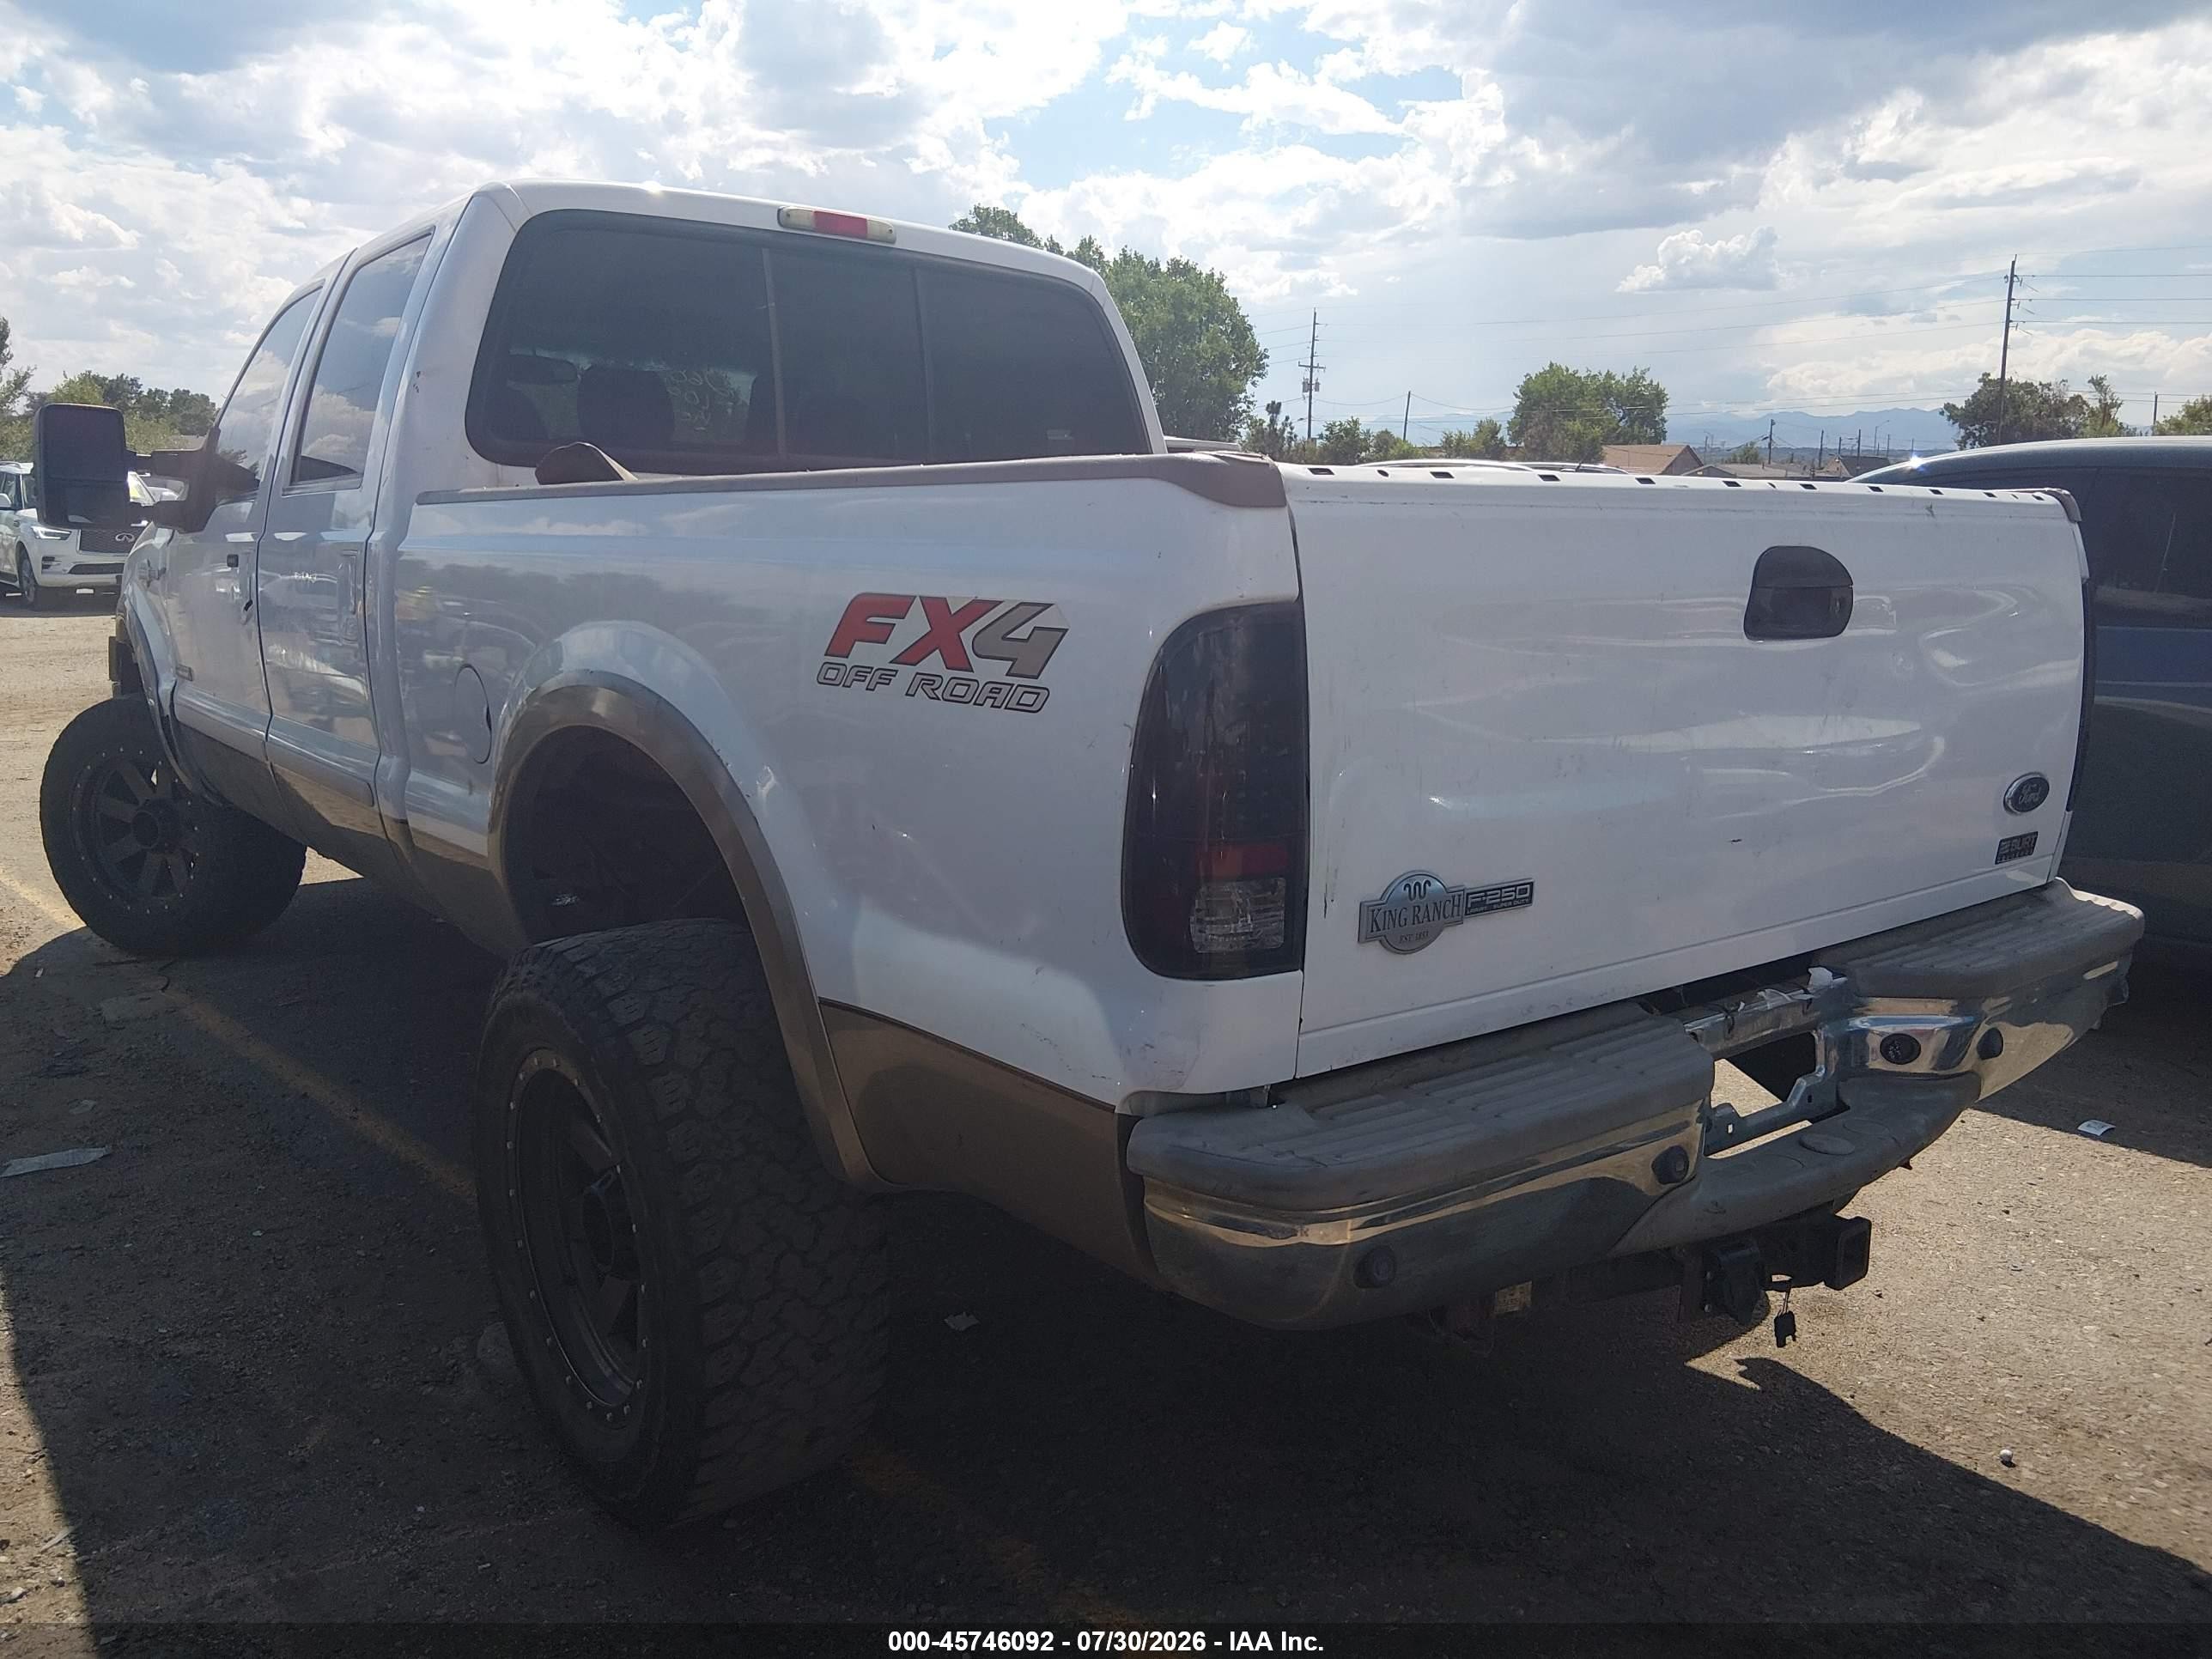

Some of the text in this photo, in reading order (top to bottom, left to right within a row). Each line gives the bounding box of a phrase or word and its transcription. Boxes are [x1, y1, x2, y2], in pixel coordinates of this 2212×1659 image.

[823, 592, 1070, 679] FX4
[817, 661, 1051, 714] OFF ROAD
[1370, 894, 1462, 933] KING RANCH
